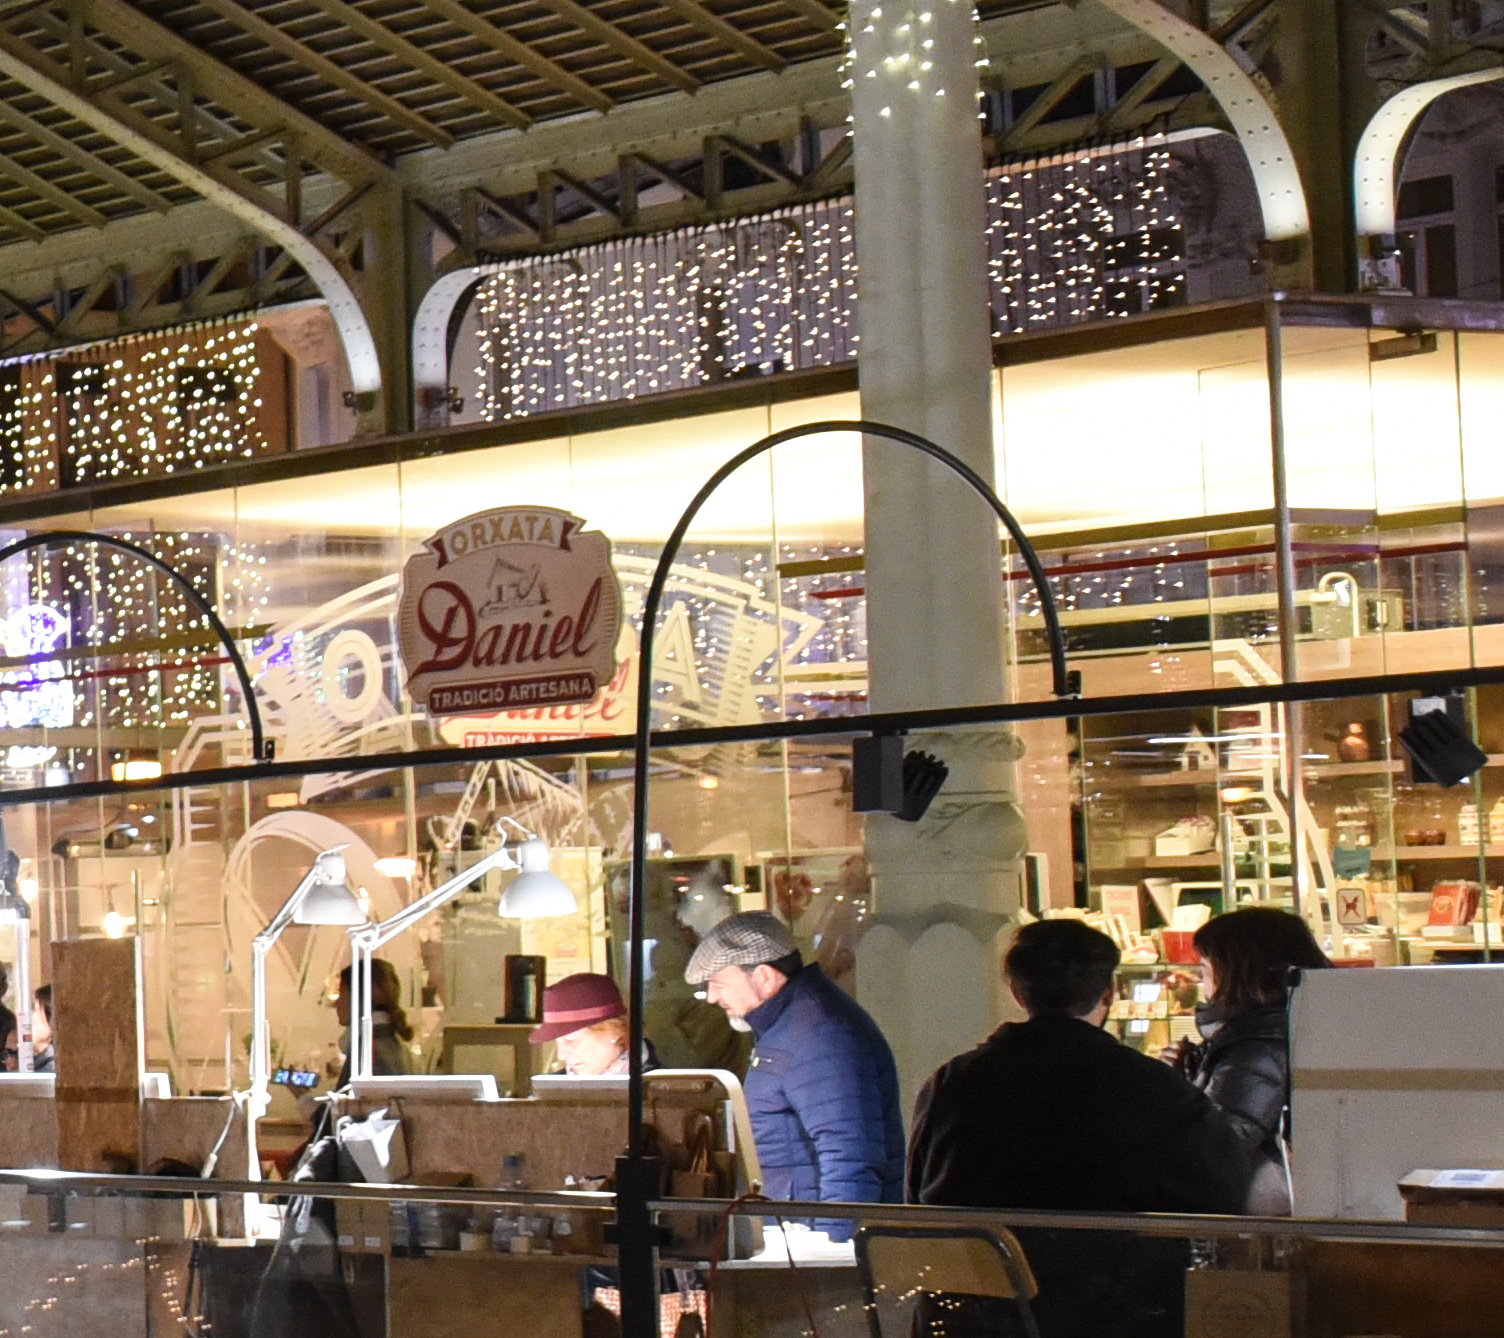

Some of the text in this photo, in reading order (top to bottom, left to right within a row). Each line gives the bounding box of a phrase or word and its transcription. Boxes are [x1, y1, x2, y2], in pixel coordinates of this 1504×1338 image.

[450, 515, 555, 555] ORXATA
[405, 576, 603, 688] Daniel
[432, 677, 593, 709] TRADICIÓ ARTESANA
